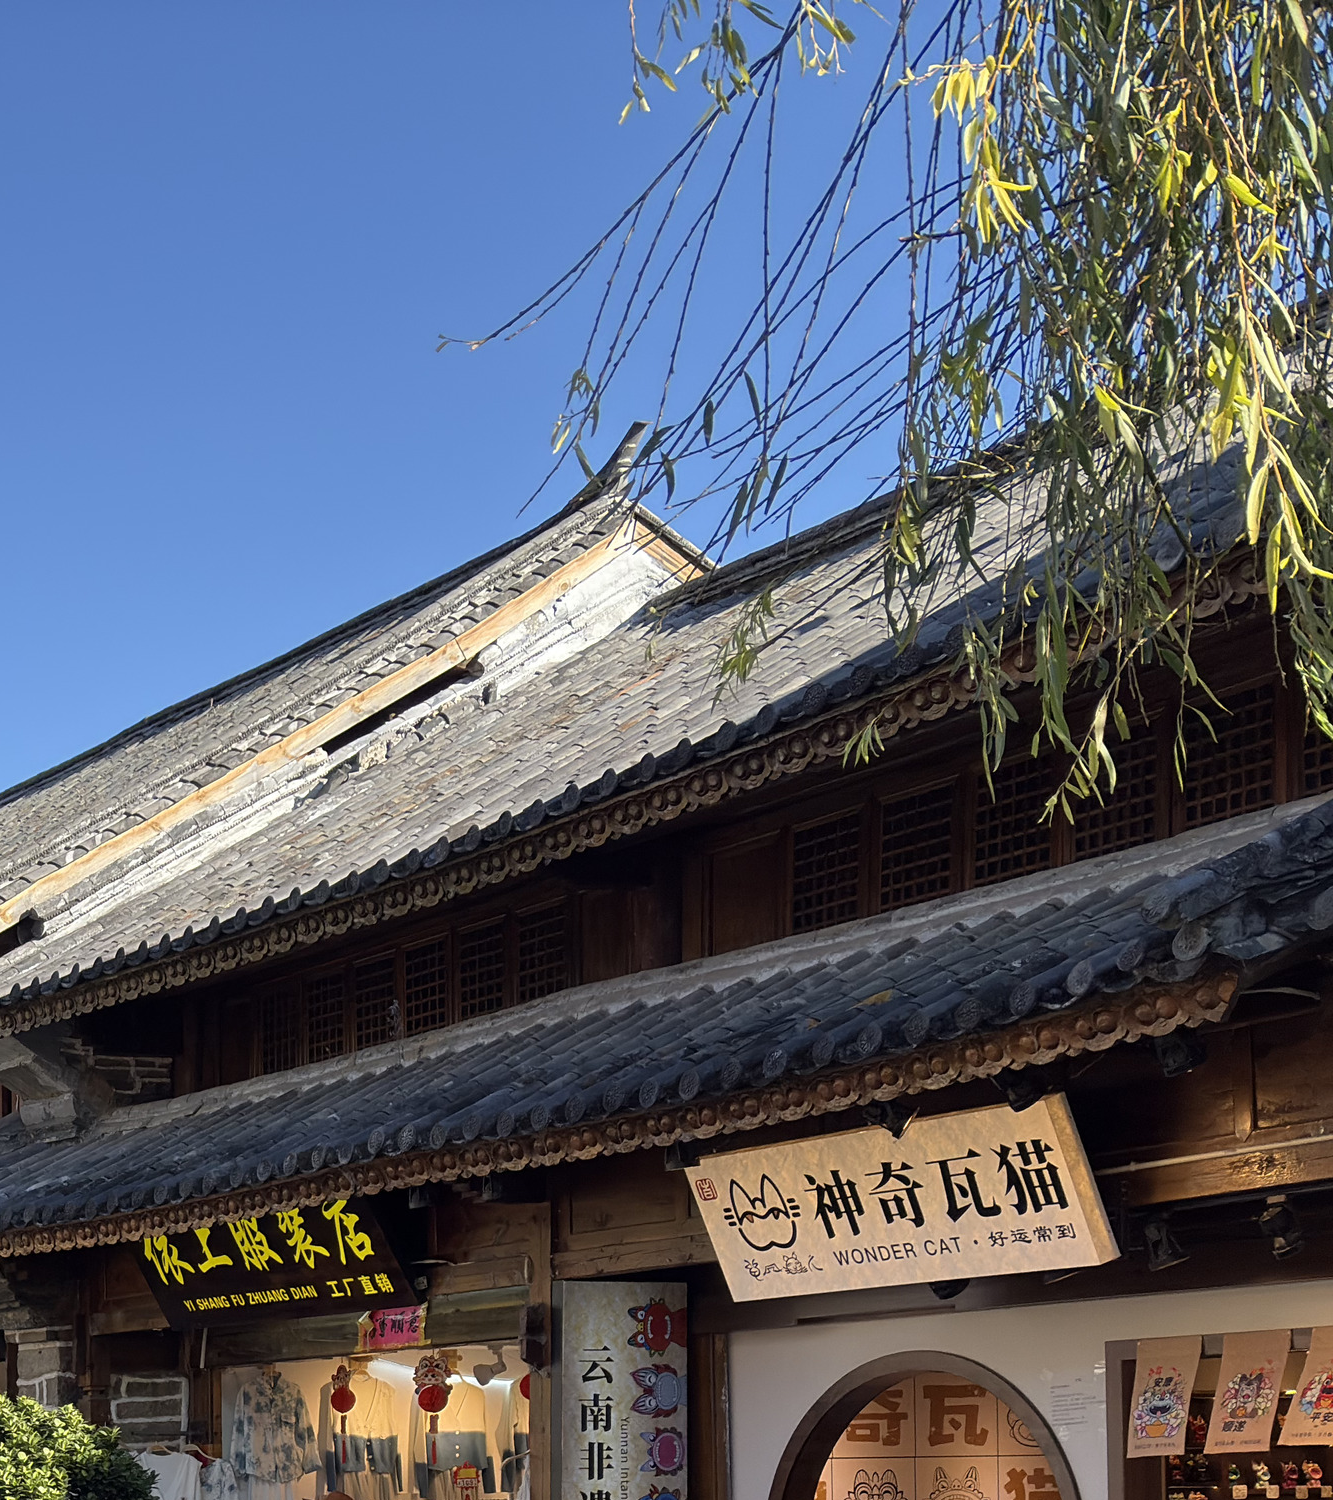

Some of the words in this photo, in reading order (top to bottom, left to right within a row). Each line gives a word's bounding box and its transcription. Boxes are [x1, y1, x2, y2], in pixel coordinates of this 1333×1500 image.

[803, 1138, 1070, 1239] 神奇瓦猫
[833, 1242, 916, 1267] WONDER
[923, 1236, 963, 1257] CAT
[987, 1222, 1077, 1248] 好运常到
[183, 1300, 195, 1313] YI
[196, 1297, 231, 1311] SHANG
[231, 1294, 245, 1307] FU
[248, 1288, 289, 1305] ZHUANG
[291, 1285, 318, 1300] DIAN
[326, 1272, 395, 1298] 工厂直销
[619, 1416, 631, 1463] Yunnan
